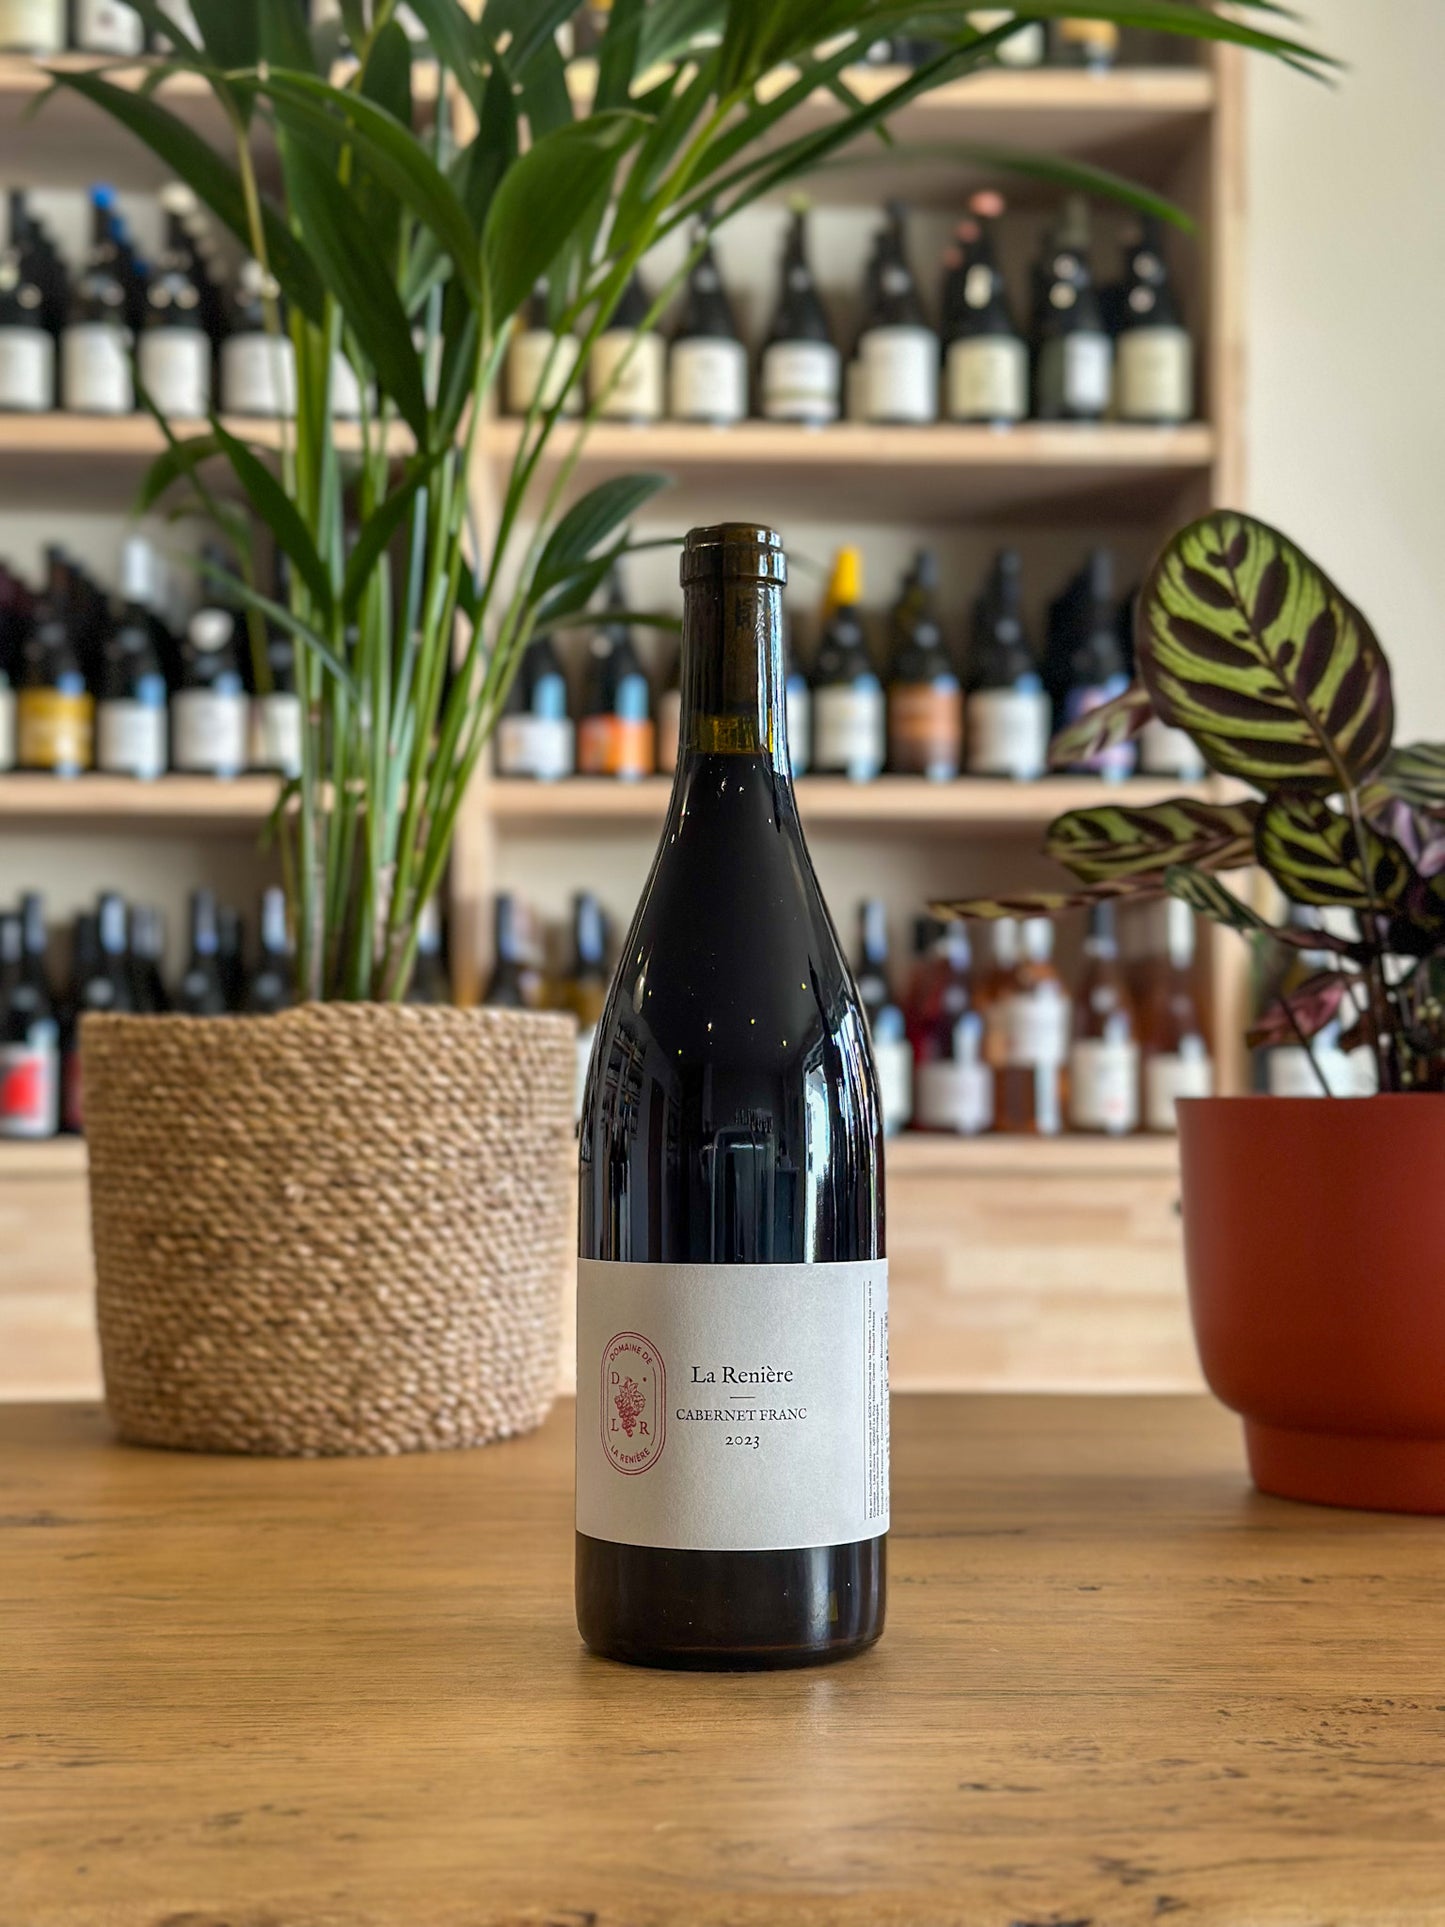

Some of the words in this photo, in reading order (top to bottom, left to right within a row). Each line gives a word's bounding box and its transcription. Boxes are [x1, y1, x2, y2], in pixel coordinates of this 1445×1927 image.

[610, 1343, 641, 1361] DOMAINE
[642, 1351, 652, 1364] DE
[611, 1371, 620, 1385] D
[691, 1366, 716, 1383] La
[722, 1365, 793, 1384] Renière
[676, 1408, 756, 1421] CABERNET
[760, 1407, 807, 1421] FRANC
[611, 1418, 619, 1432] L
[639, 1421, 650, 1435] R
[725, 1436, 760, 1449] 2023
[611, 1445, 619, 1457] LA
[620, 1447, 651, 1464] RENIÈRE
